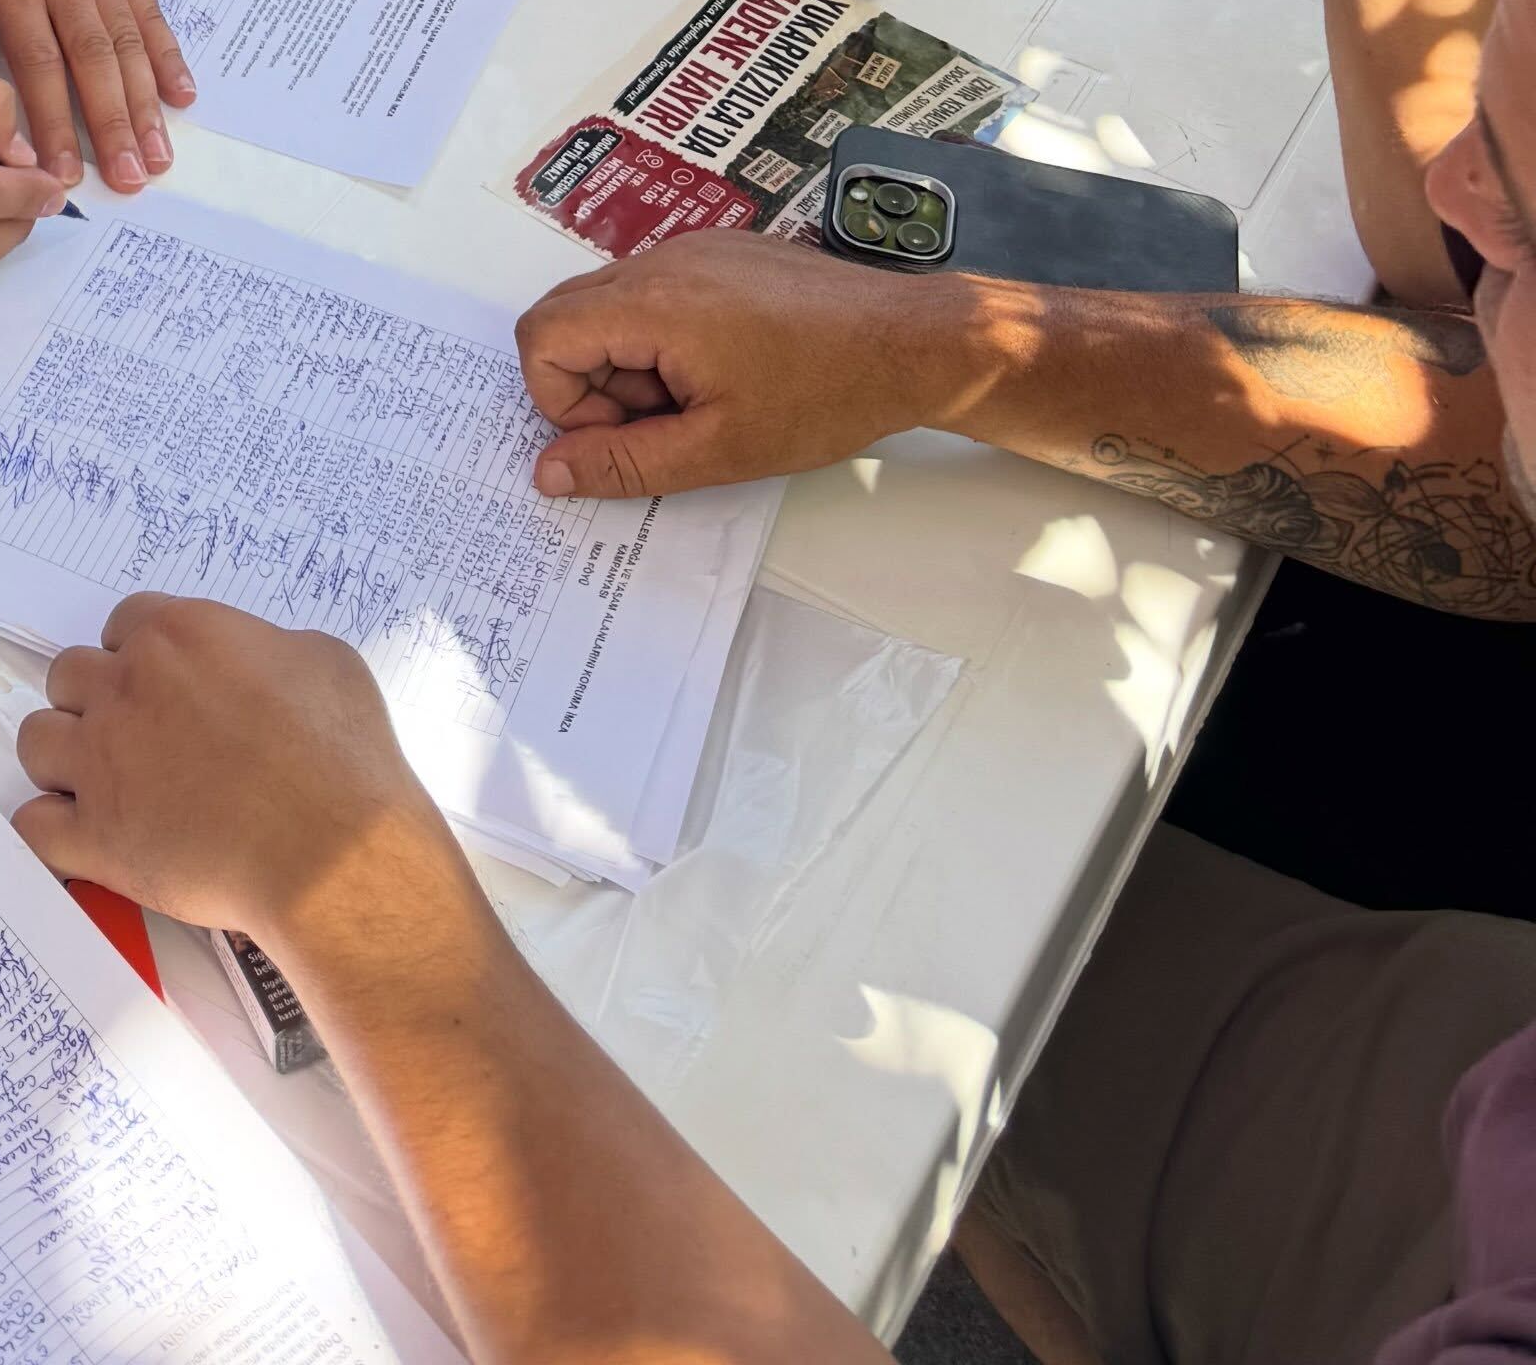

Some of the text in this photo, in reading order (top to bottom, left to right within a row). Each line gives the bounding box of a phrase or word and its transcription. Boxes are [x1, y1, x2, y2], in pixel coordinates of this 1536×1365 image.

[634, 59, 729, 141] HAYIR!
[952, 75, 1000, 102] İZMİR
[581, 156, 624, 193] MEYDANI
[626, 170, 649, 189] YER:
[573, 163, 637, 220] YUKARIKIZILCA
[638, 179, 667, 205] 11:00
[654, 187, 680, 208] SAAT:
[680, 196, 697, 209] 19
[648, 206, 685, 239] TEMMUZ
[681, 203, 710, 227] TARİH:
[550, 544, 576, 584] TELEFON
[577, 539, 608, 587] İMZA FÖYÜ
[596, 543, 629, 599] KAMPANYASI
[623, 541, 645, 571] DOĞA
[618, 566, 632, 581] VE
[605, 577, 628, 612] YAŞAM
[583, 612, 616, 669] ALANLARINI
[565, 669, 593, 713] KORUMA
[556, 710, 576, 735] İMZA
[246, 949, 265, 964] Sig
